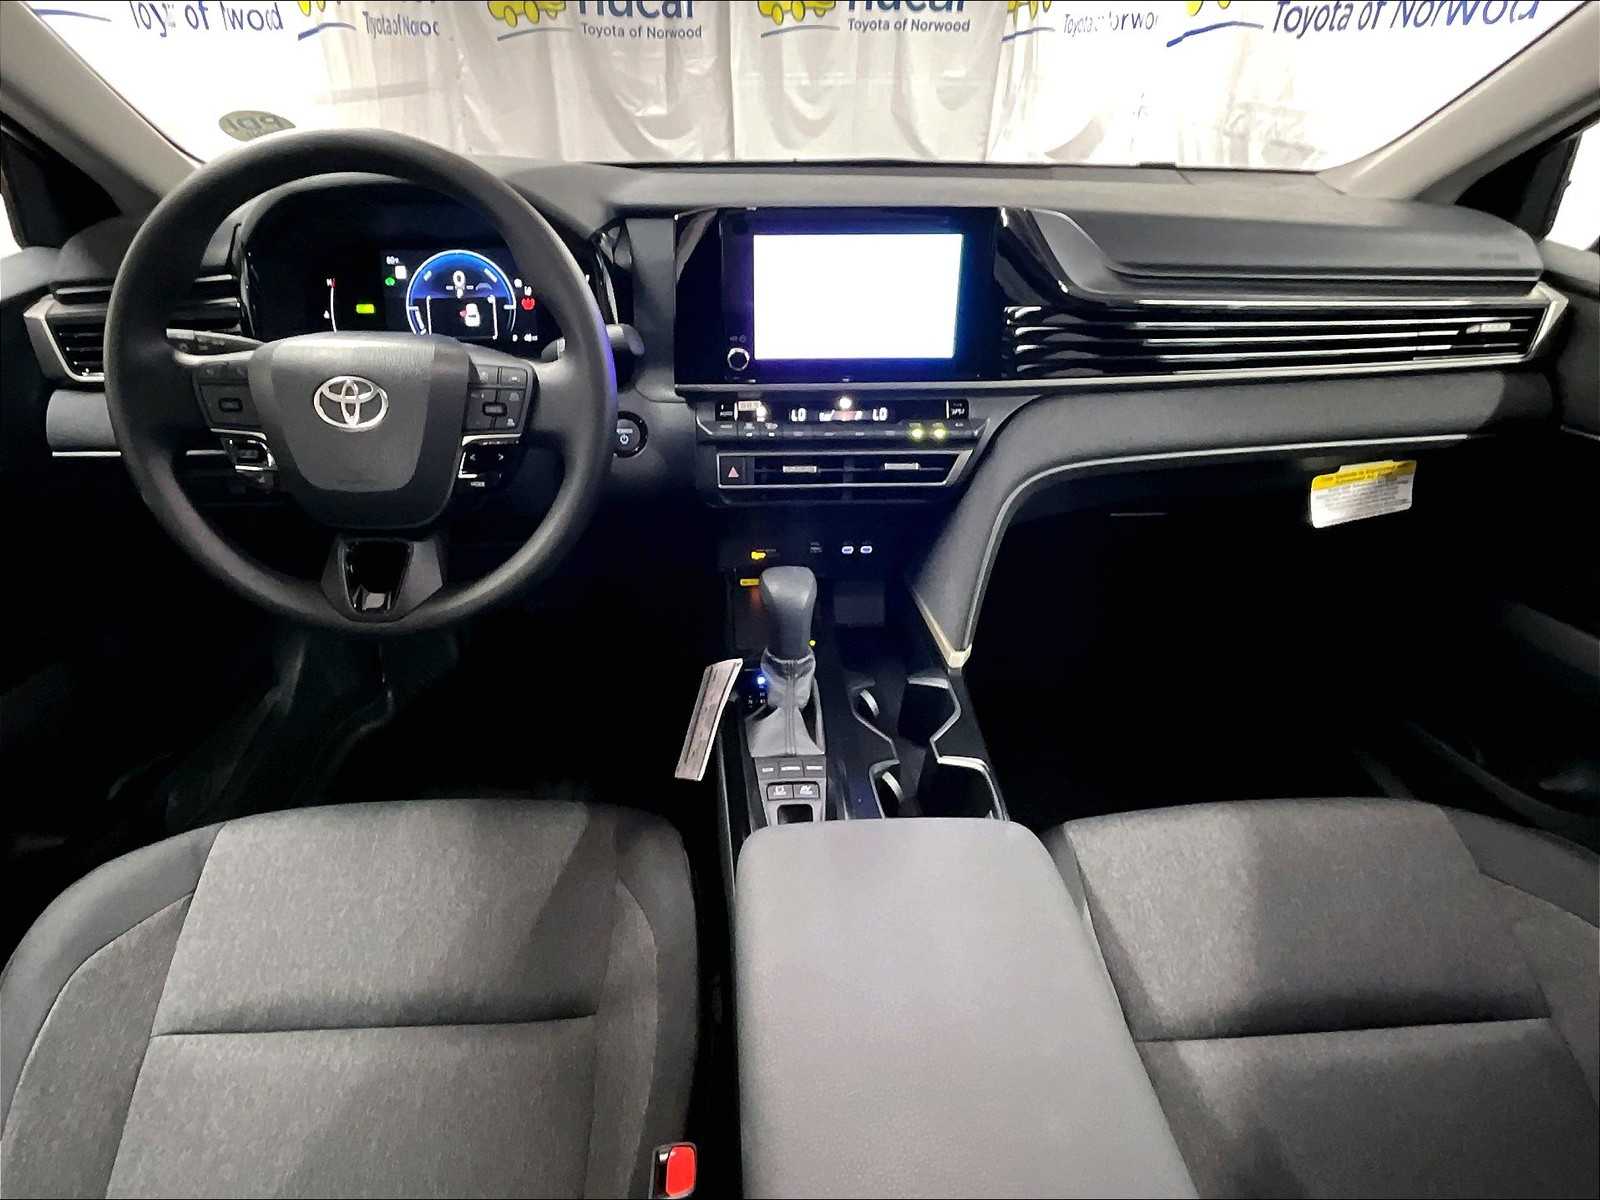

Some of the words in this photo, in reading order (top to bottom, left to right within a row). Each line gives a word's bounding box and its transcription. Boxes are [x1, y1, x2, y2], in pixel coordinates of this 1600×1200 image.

[848, 18, 890, 32] Toyota
[893, 18, 908, 31] of
[910, 19, 971, 32] Norwood
[1273, 1, 1352, 39] Toyota
[1357, 1, 1387, 30] of
[581, 22, 625, 38] Toyota
[629, 26, 642, 37] of
[646, 25, 703, 39] Norwood
[790, 407, 807, 422] LO
[872, 406, 888, 421] LO
